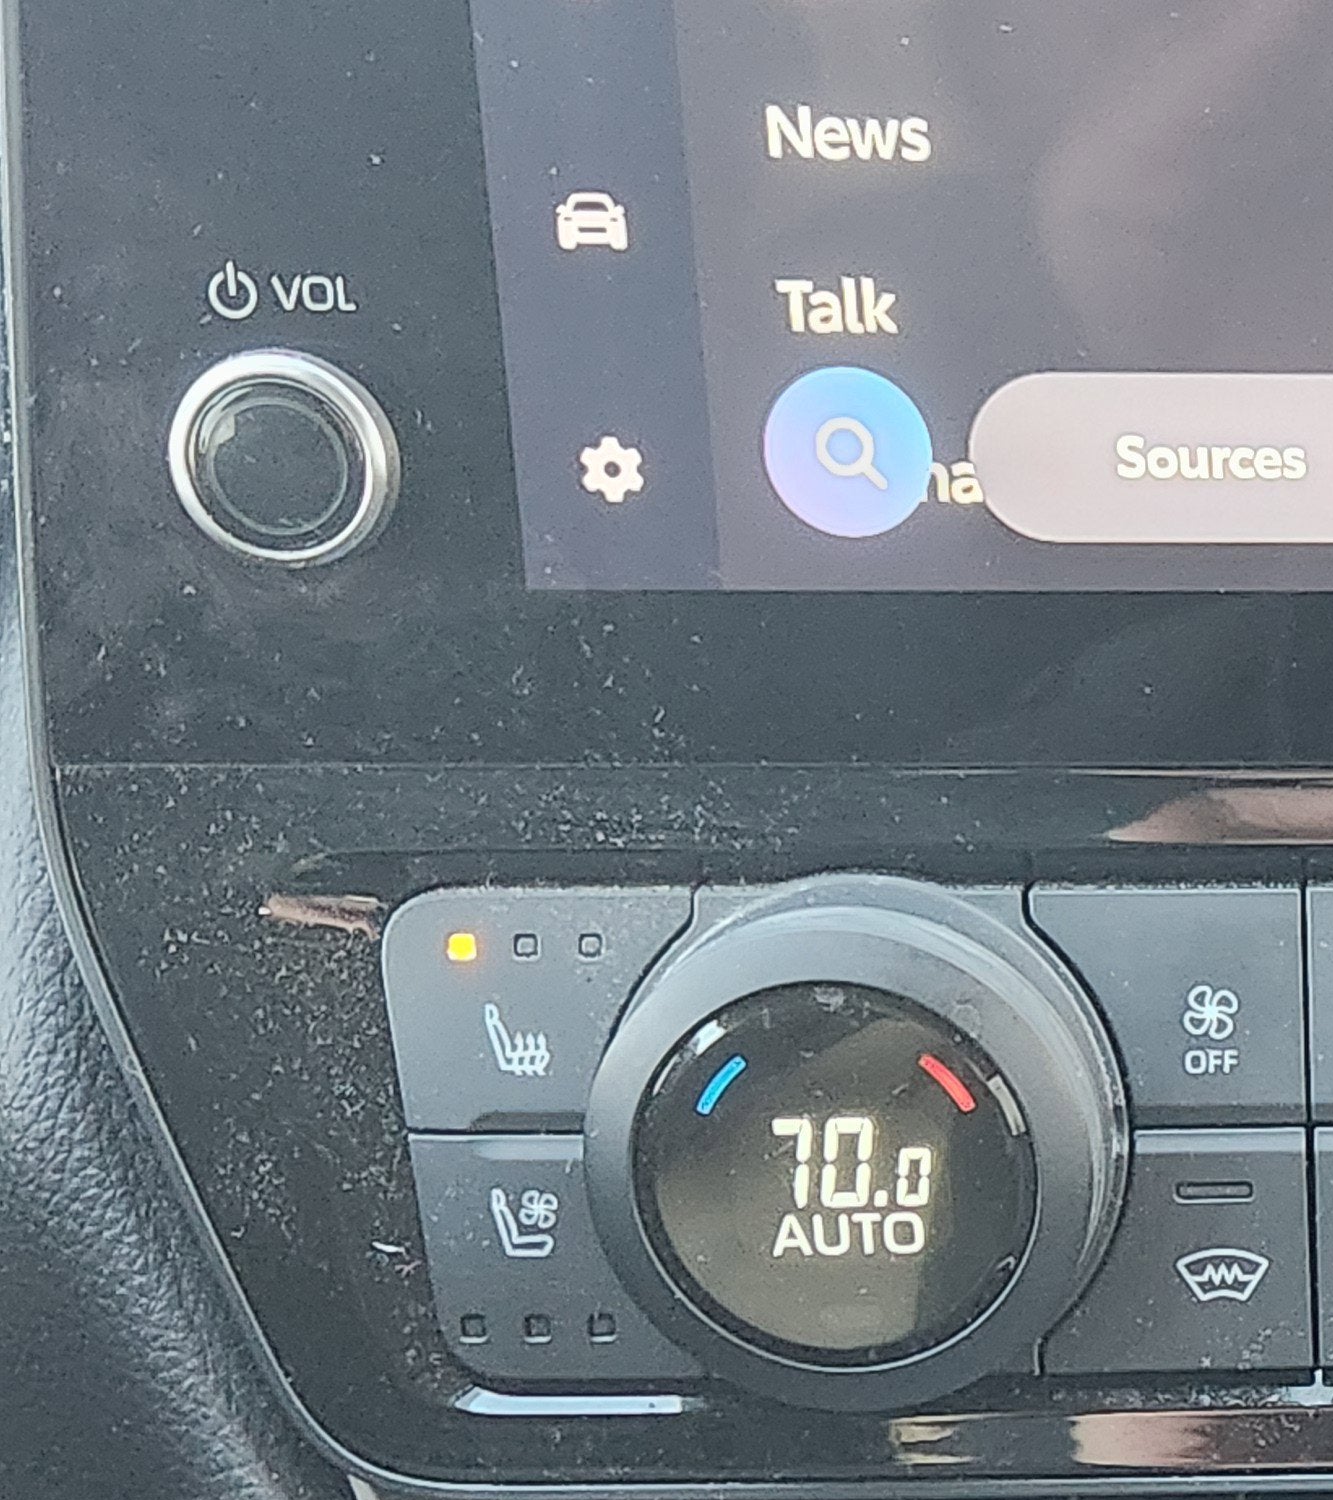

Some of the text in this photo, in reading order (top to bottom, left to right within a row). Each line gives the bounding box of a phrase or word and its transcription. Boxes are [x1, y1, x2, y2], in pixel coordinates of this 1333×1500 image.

[765, 104, 933, 162] News
[271, 274, 358, 313] VOL
[775, 278, 900, 335] Talk
[1115, 434, 1308, 482] Sources
[1184, 1049, 1239, 1075] OFF
[771, 1117, 933, 1209] 70.0
[771, 1212, 926, 1258] AUTO
